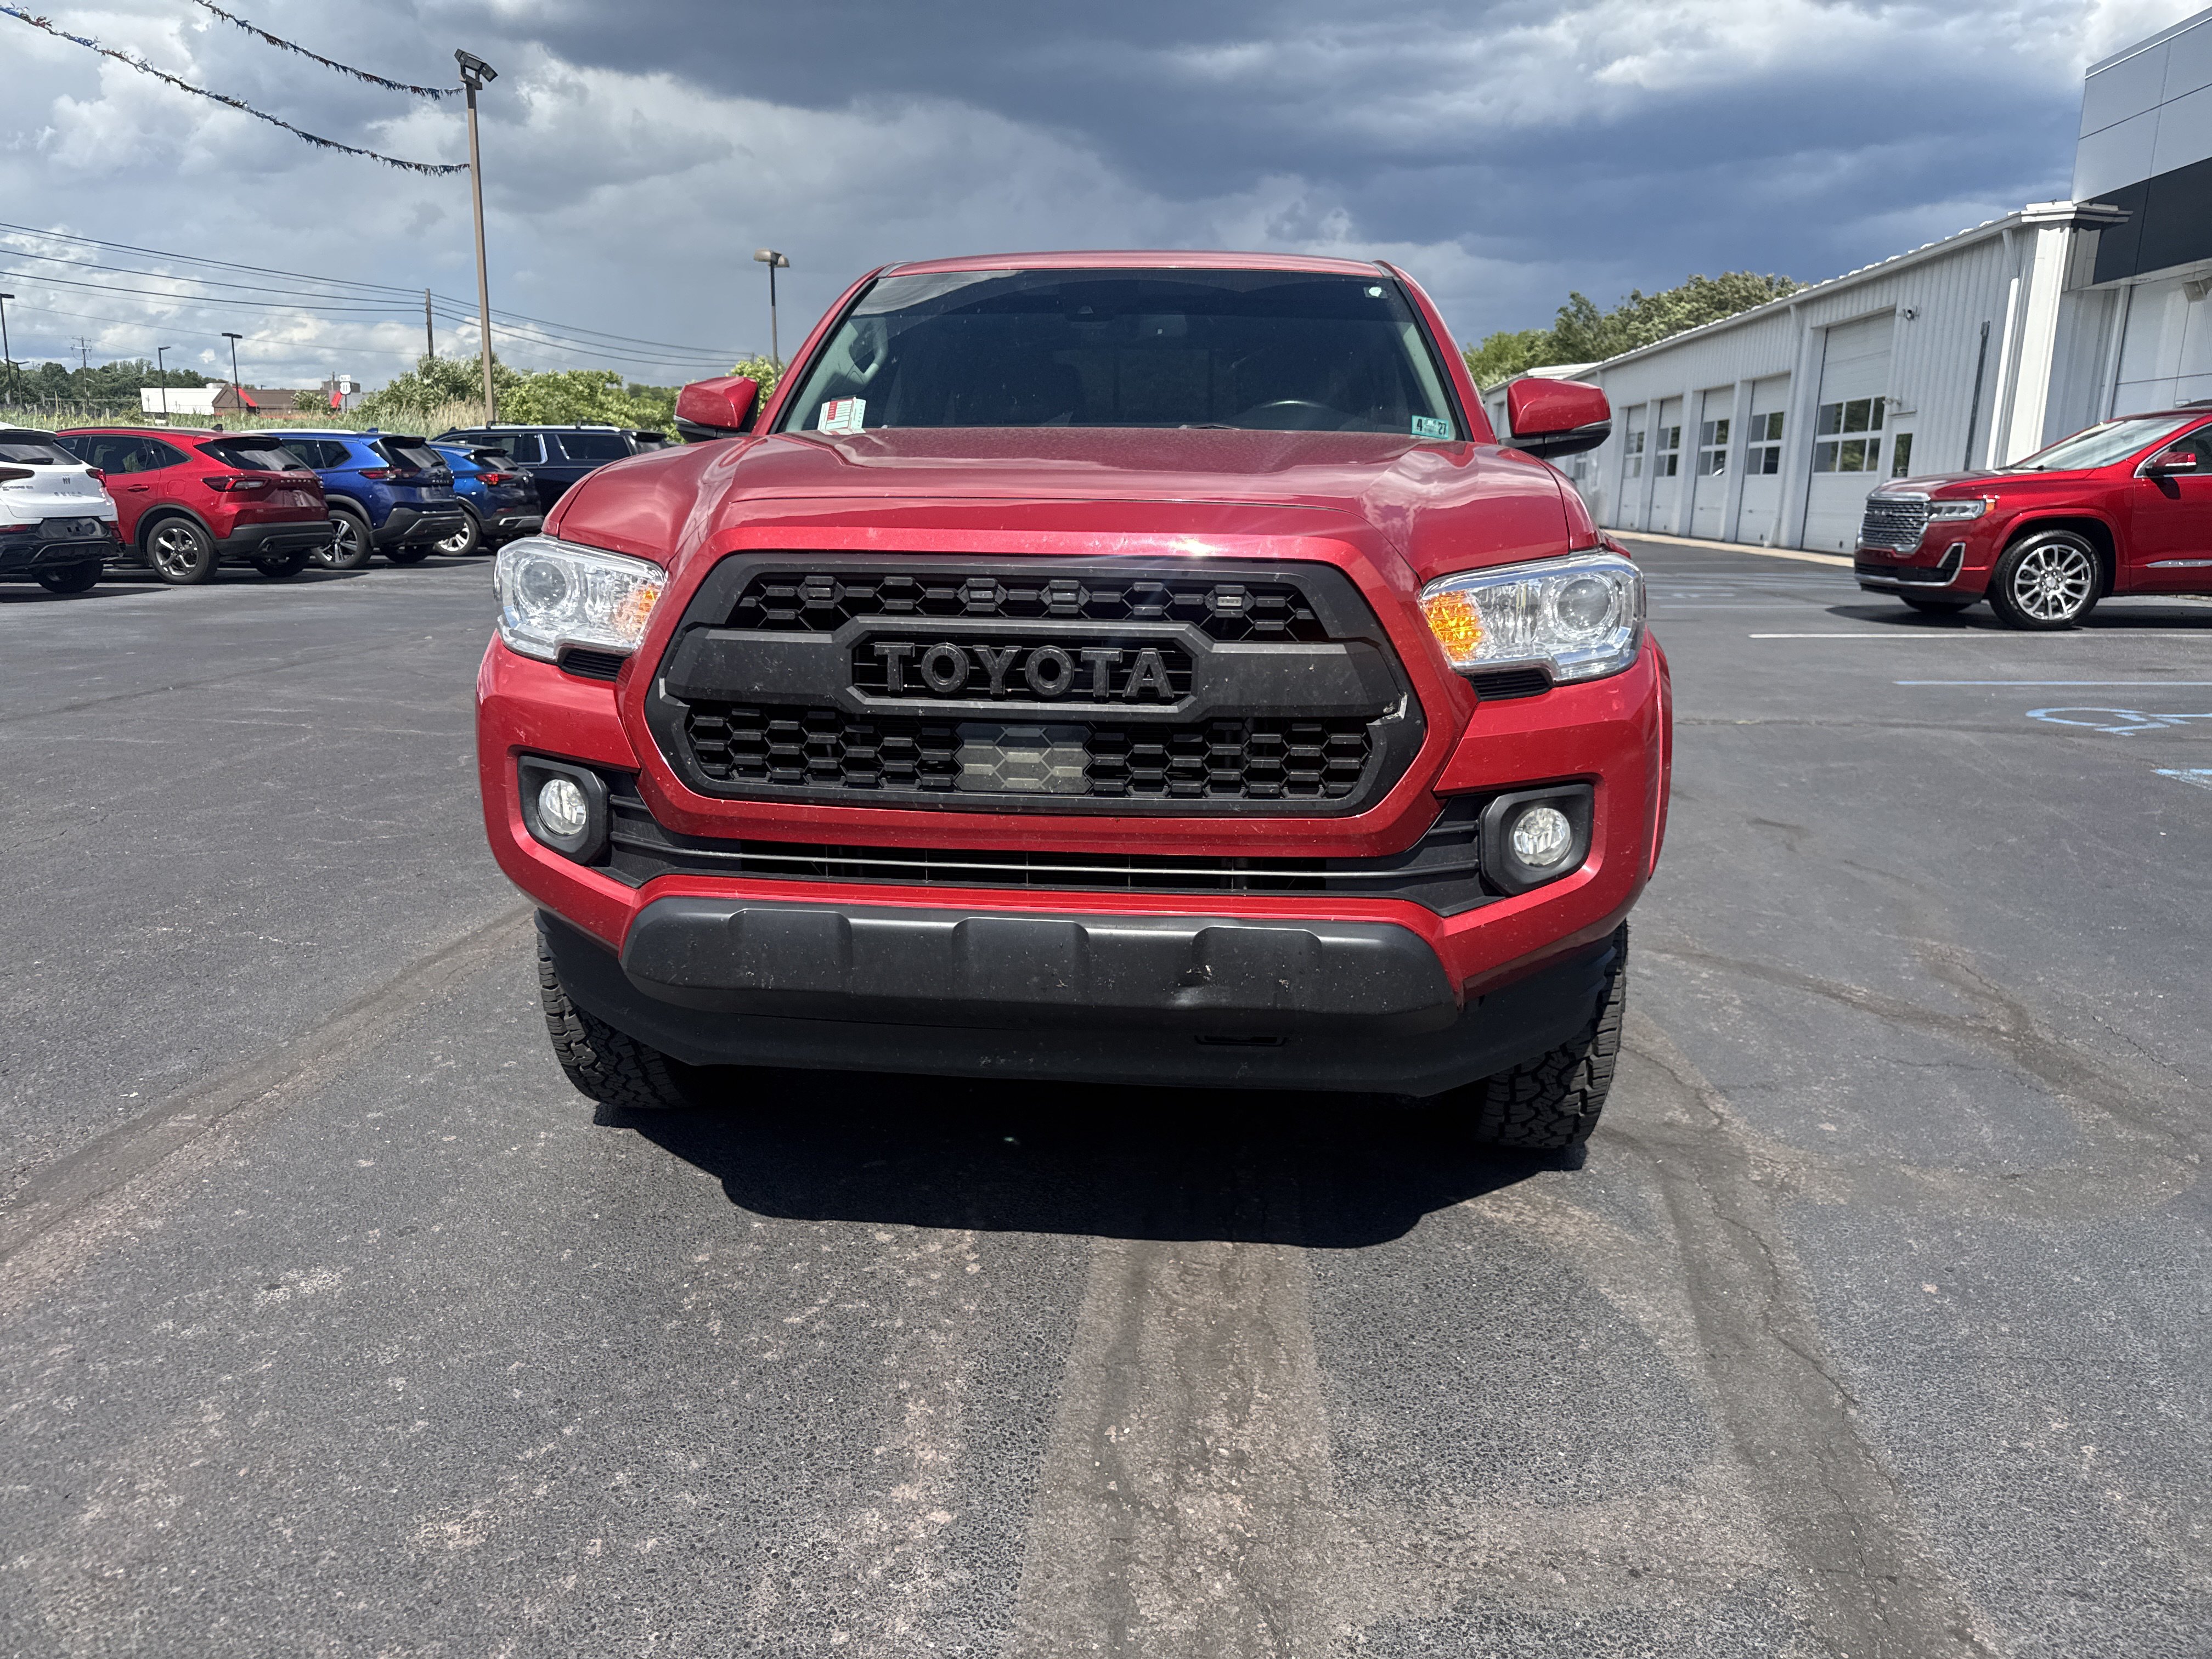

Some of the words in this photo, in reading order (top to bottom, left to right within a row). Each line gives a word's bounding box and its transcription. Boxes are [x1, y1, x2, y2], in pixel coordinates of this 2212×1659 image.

[1417, 419, 1423, 432] 4
[1438, 421, 1447, 435] 27
[874, 642, 1174, 698] TOYOTA
